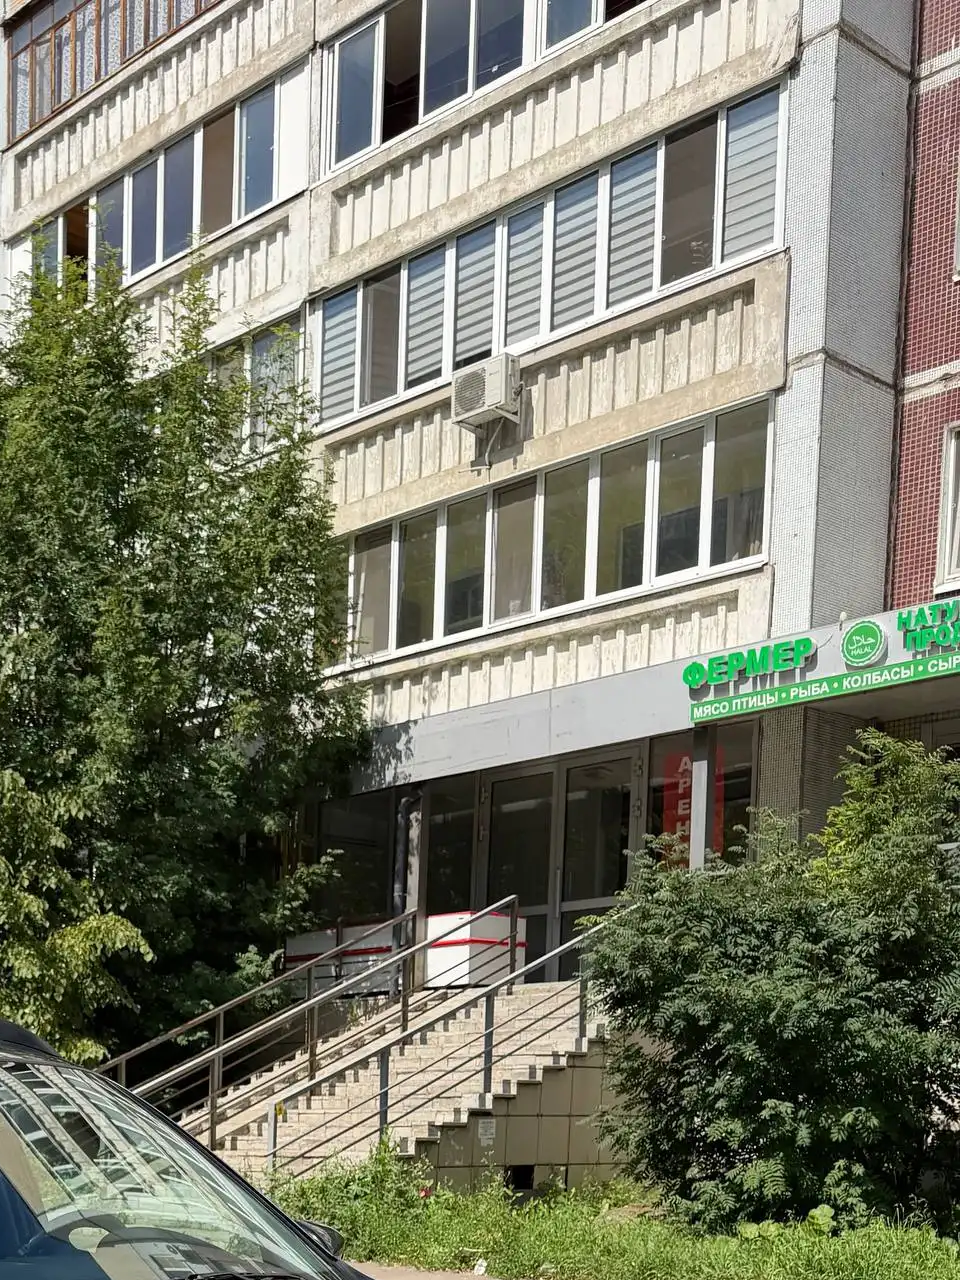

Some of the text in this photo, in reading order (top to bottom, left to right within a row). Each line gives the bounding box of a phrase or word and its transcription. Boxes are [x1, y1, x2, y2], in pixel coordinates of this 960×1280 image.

[897, 600, 960, 632] НАТУ
[682, 637, 815, 689] ФЕРМЕР
[851, 646, 873, 656] HALAL
[693, 702, 729, 719] МЯСО
[732, 691, 778, 712] ПТИЦЫ
[790, 682, 830, 699] РЫБА
[842, 664, 914, 690] КОЛБАСЫ
[676, 756, 692, 836] АРЕН
